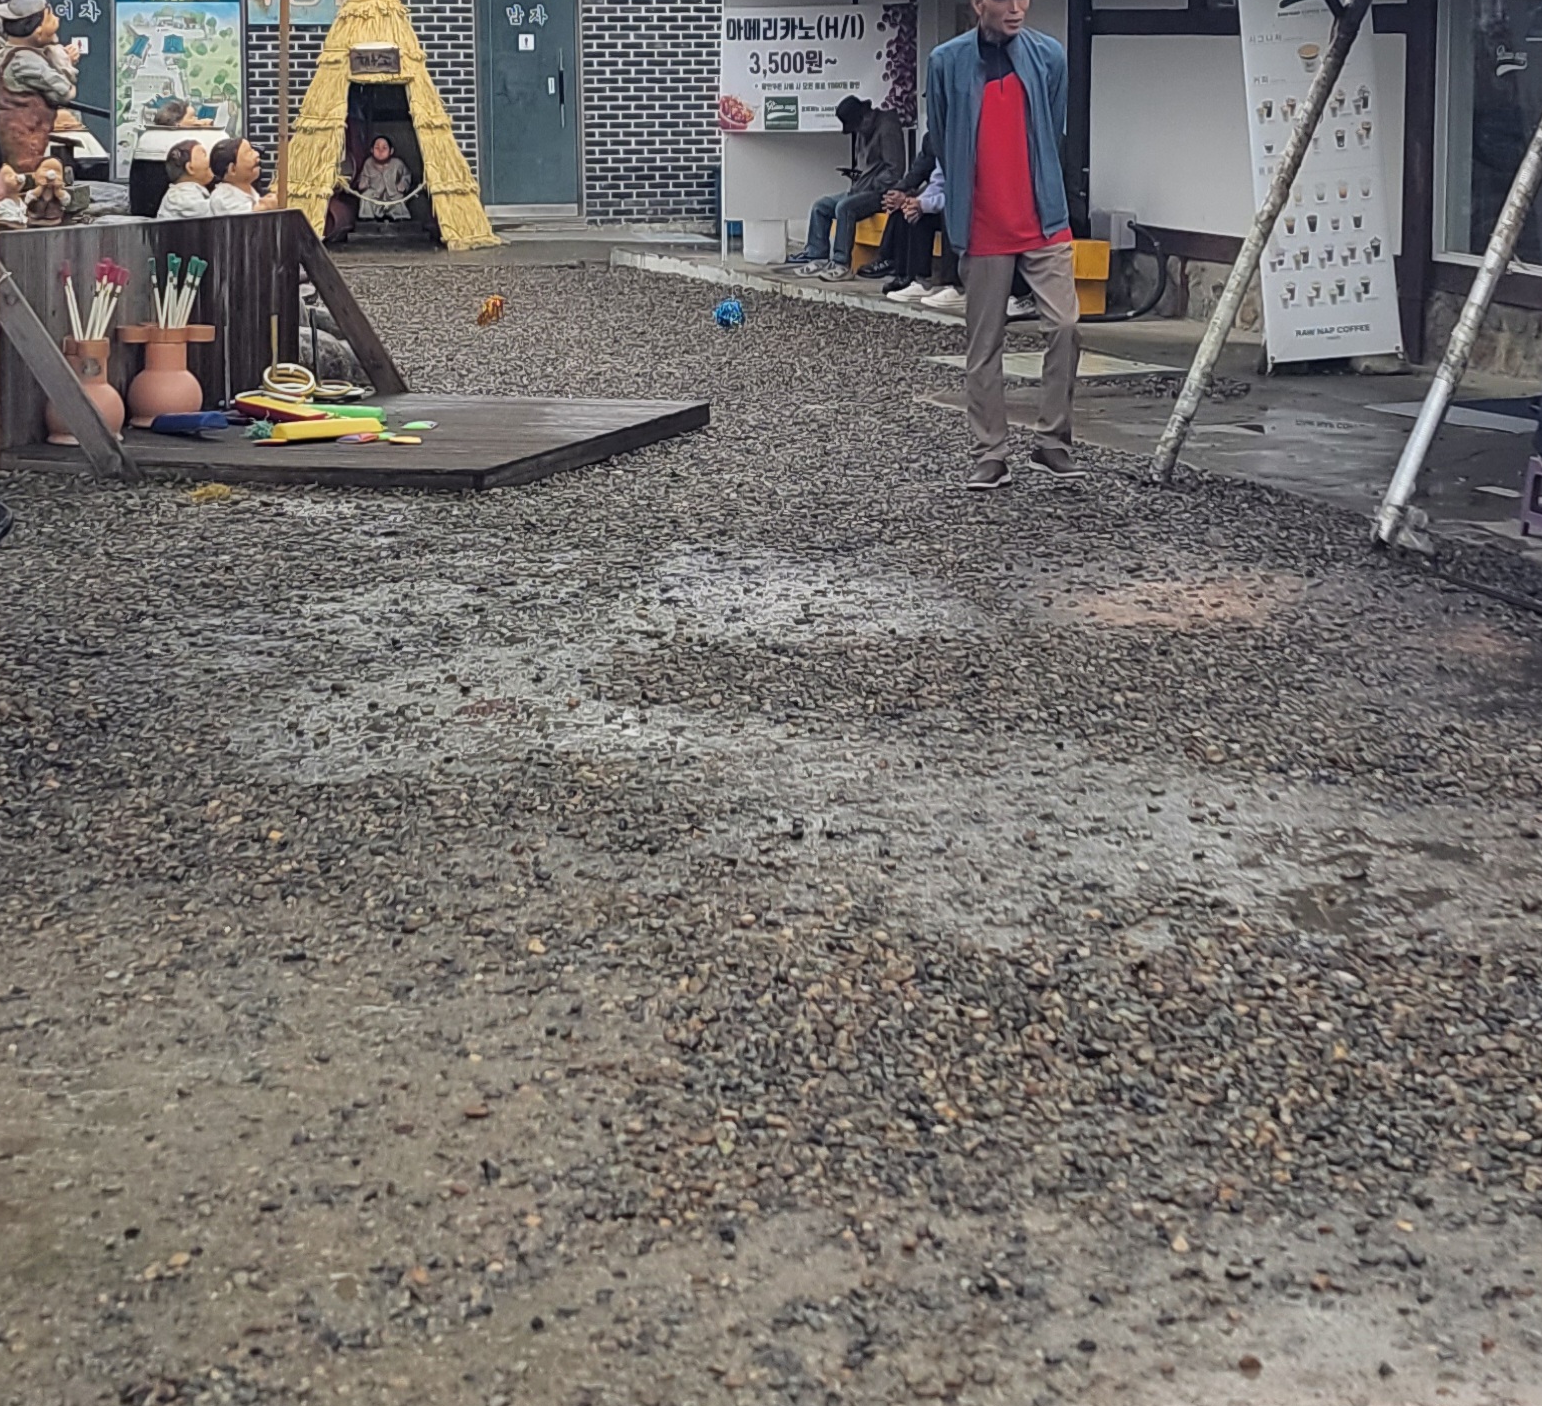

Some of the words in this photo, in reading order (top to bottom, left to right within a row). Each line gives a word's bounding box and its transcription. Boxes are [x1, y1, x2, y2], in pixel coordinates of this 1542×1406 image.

[505, 3, 549, 27] 남자
[726, 13, 865, 41] 아메리카노(H/I)
[749, 49, 838, 78] 3,500원~
